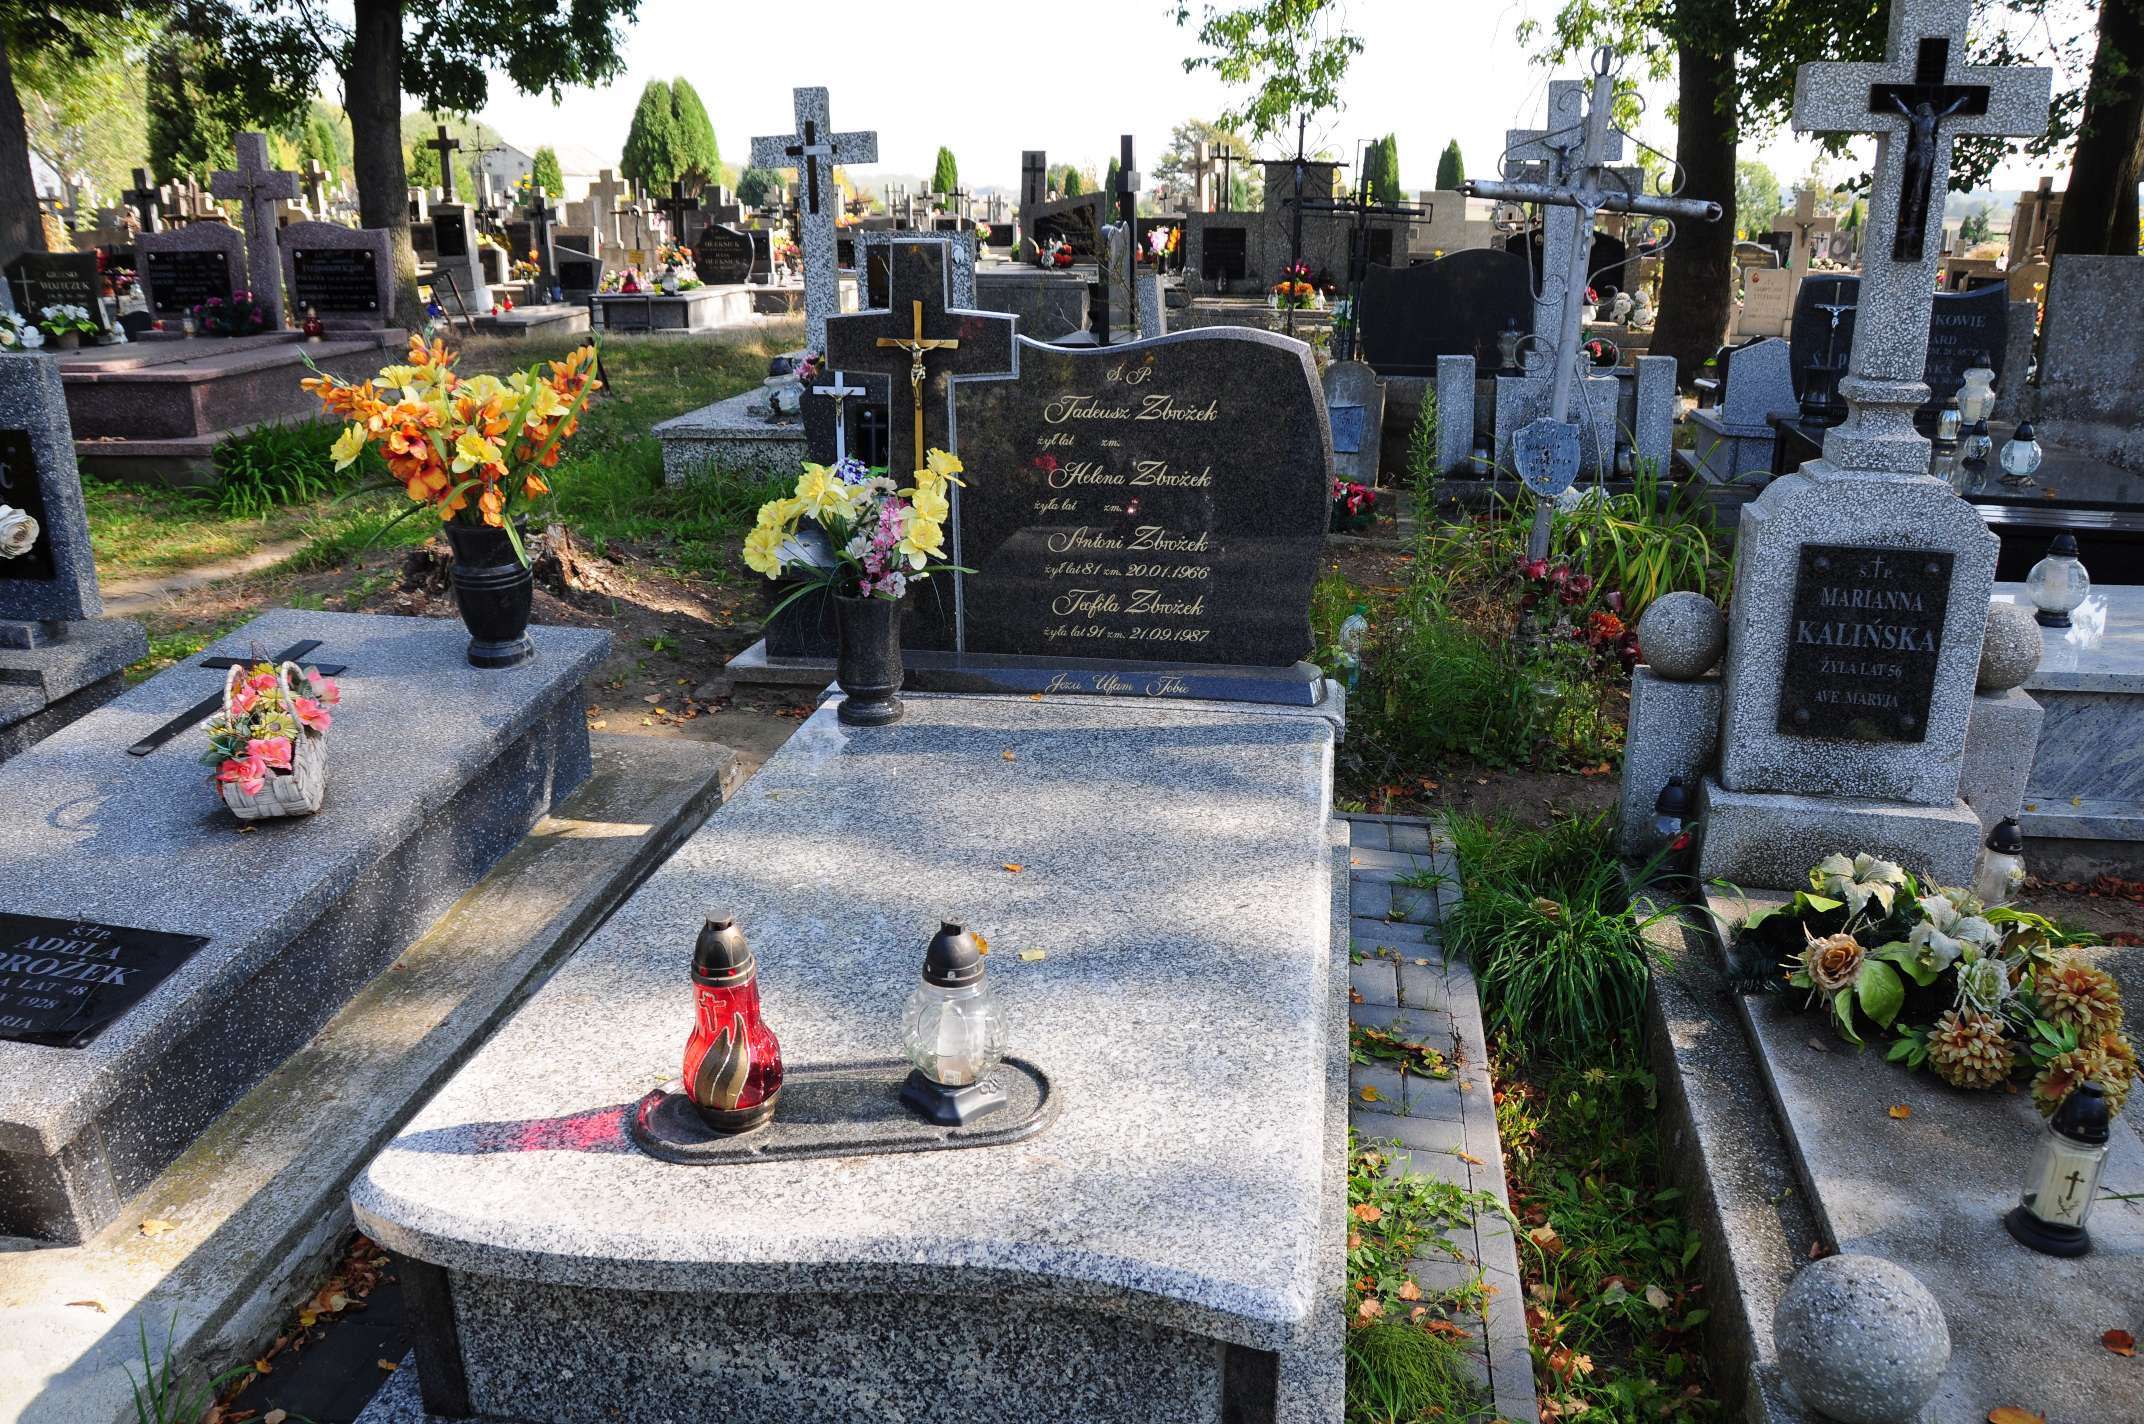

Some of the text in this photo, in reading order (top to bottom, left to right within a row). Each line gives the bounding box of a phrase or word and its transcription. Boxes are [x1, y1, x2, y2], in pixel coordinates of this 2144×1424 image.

[1933, 314, 1986, 328] KOWIE
[1126, 366, 1152, 385] P.
[1044, 394, 1218, 424] Tadeusz Zbrożek
[1058, 433, 1075, 446] lat
[1048, 460, 1212, 489] Helena Zbrożek
[1034, 497, 1060, 515] żyła
[1061, 498, 1078, 511] lat
[1047, 525, 1209, 553] Antoni Zbrożek
[1065, 562, 1081, 575] lat
[1081, 562, 1103, 575] 81
[1125, 563, 1211, 579] 20.01.1966
[1052, 589, 1204, 619] Teofila Zbrożek
[1819, 587, 1923, 611] MARIANNA
[1071, 625, 1087, 637] lat
[1087, 625, 1107, 638] 91
[1128, 626, 1211, 642] 21.09.1987
[1795, 618, 1937, 652] KALIŃSKA
[1860, 662, 1887, 676] LAT
[1887, 664, 1903, 679] 56
[1044, 672, 1191, 696] Jezu Ufam Tobie
[1815, 690, 1841, 703] AVE
[13, 936, 121, 960] ADELA
[16, 979, 62, 992] LAT
[16, 996, 60, 1009] 1928
